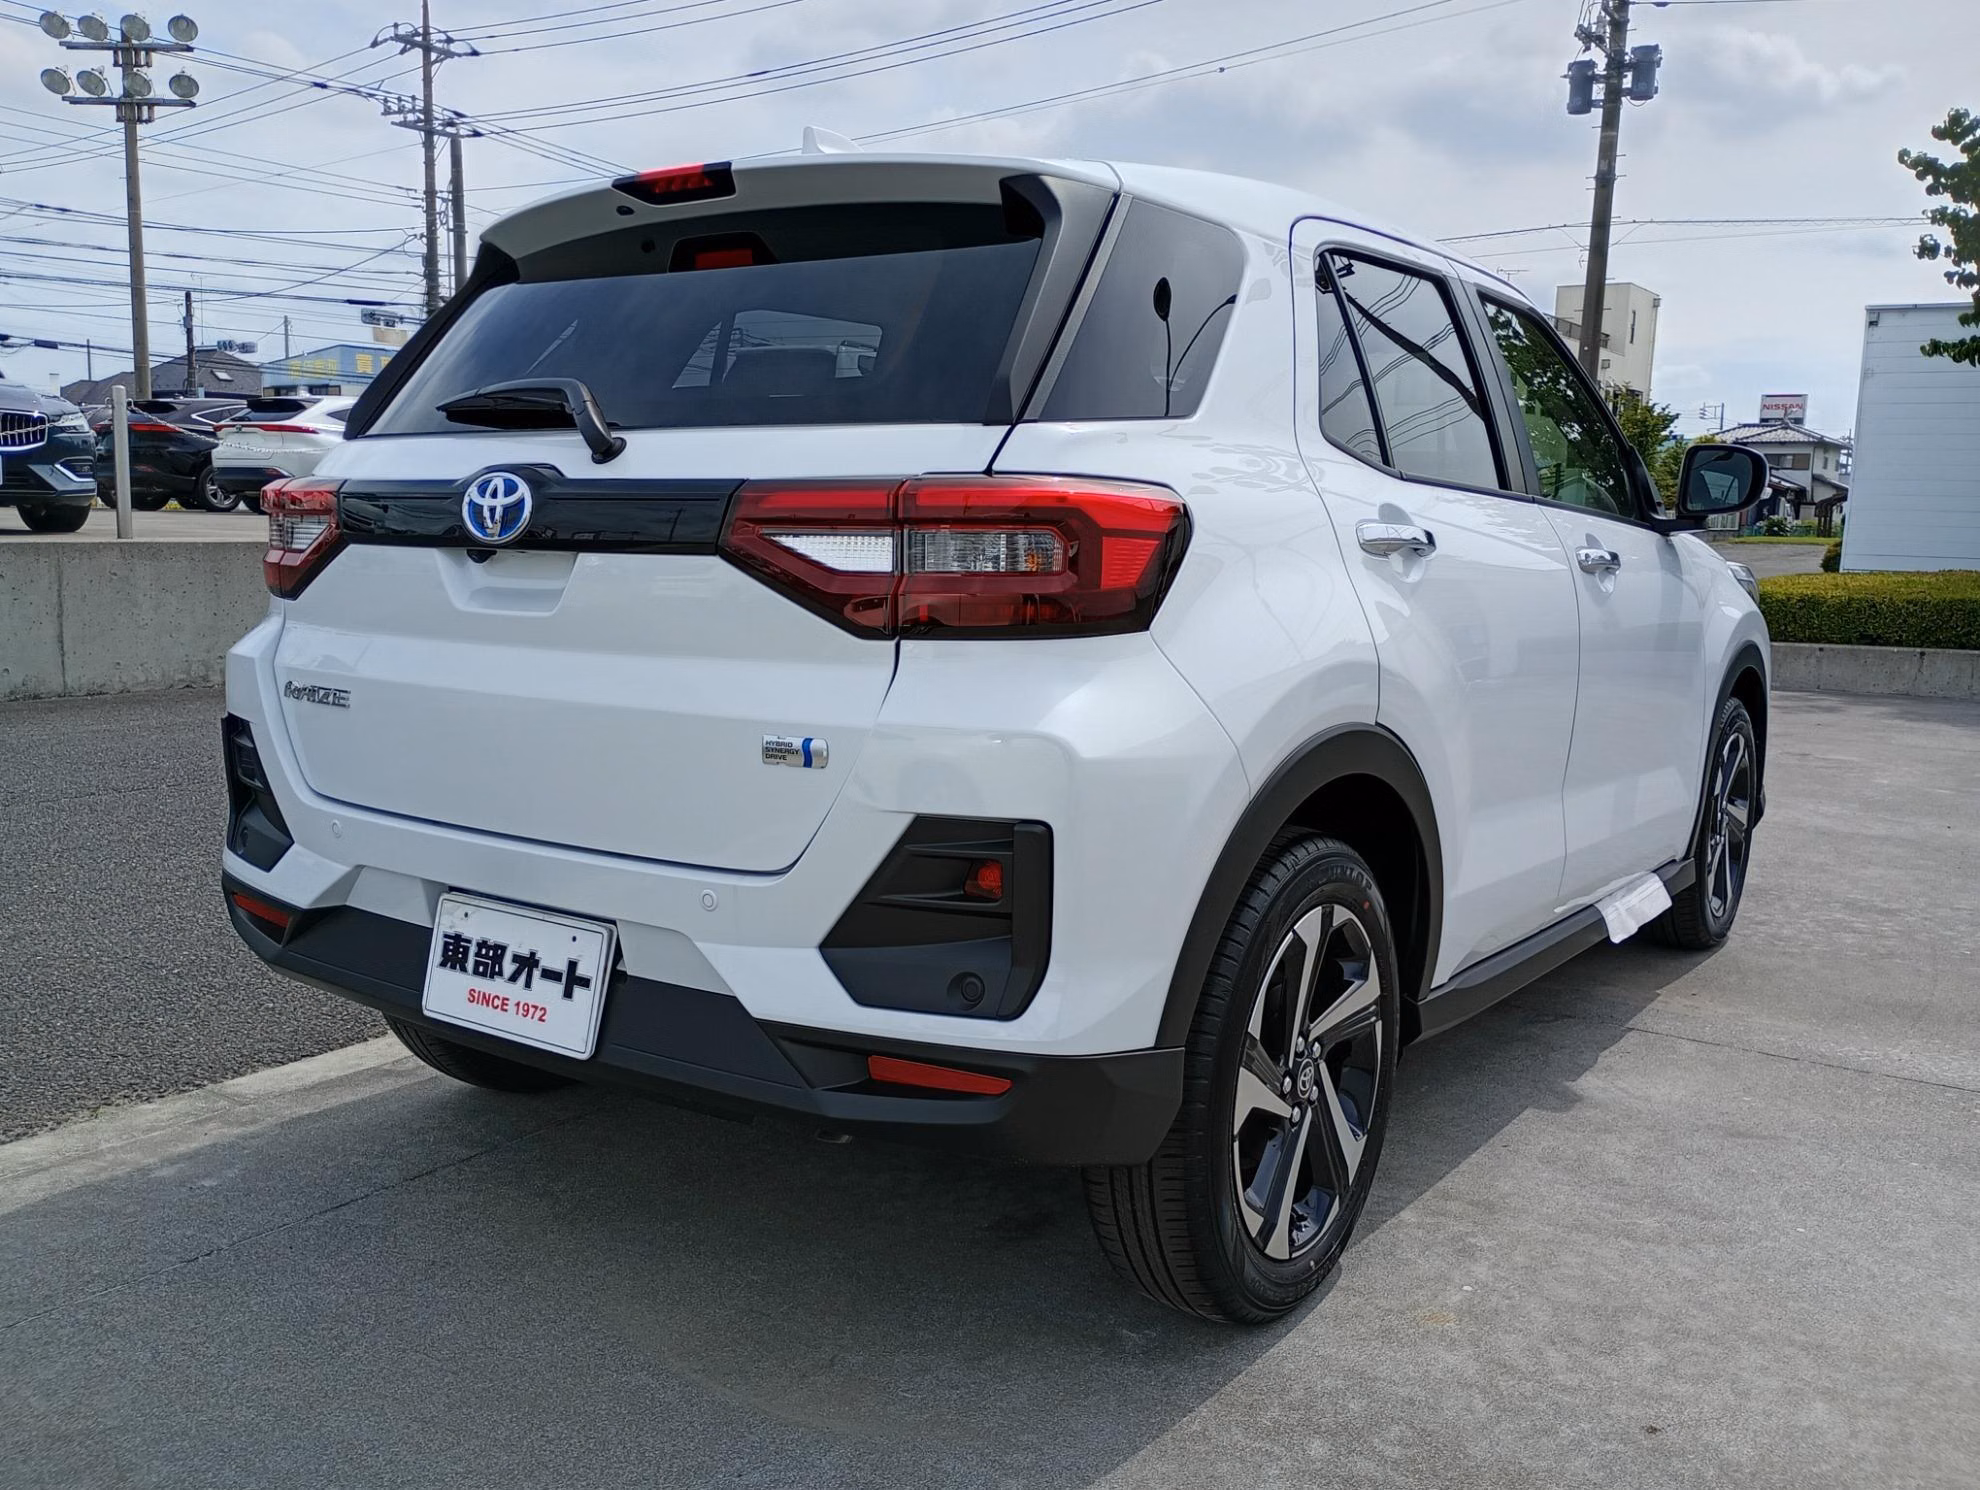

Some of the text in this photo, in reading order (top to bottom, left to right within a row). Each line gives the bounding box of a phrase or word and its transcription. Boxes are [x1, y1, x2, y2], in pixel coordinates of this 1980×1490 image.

[765, 747, 800, 755] SYNERGY
[439, 932, 592, 1000] 東部オート
[467, 988, 547, 1023] SINCE 1972
